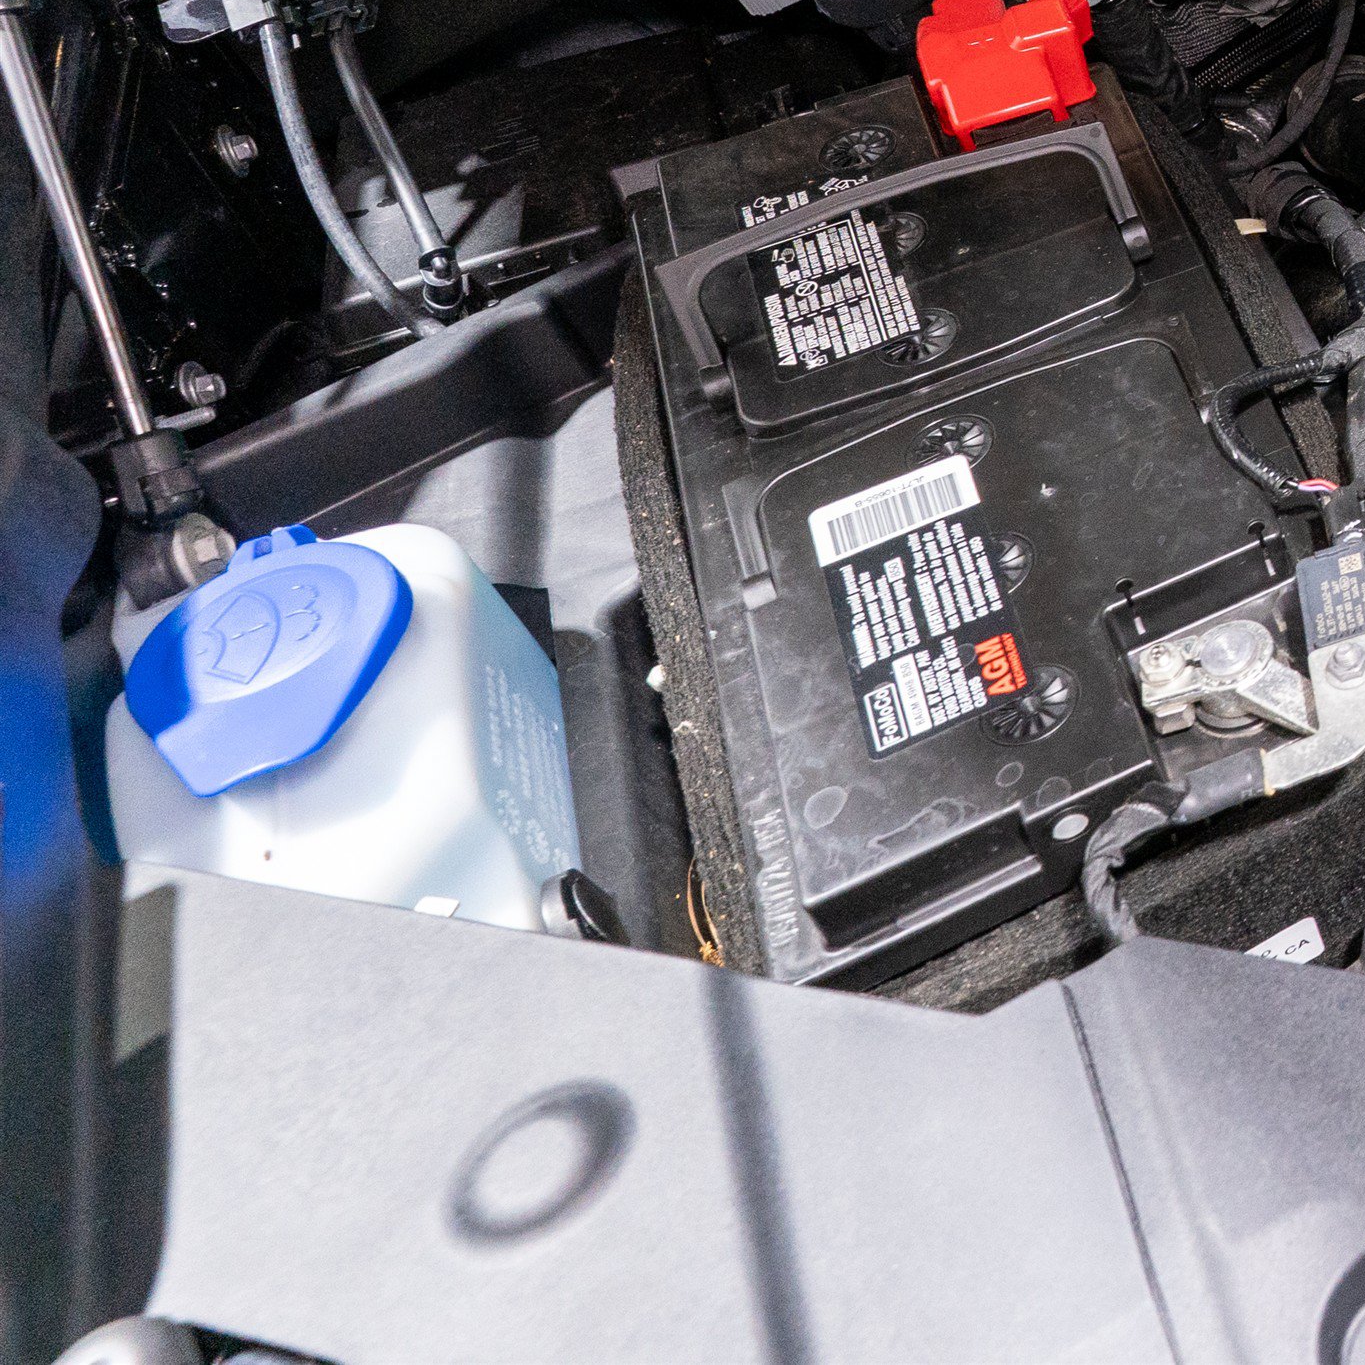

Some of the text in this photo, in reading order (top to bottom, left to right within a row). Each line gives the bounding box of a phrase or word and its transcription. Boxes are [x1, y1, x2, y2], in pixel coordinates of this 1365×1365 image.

[765, 294, 792, 356] DANGER/POISON
[969, 536, 983, 553] 850
[888, 562, 900, 577] 850
[915, 573, 944, 635] AVERTISSEMENT
[975, 637, 1014, 693] AGM
[1002, 634, 1026, 688] TECHNOLOGY
[936, 668, 953, 697] MOTOR
[873, 689, 899, 744] FoMoCo
[943, 696, 959, 719] FORD
[1285, 939, 1309, 955] CA
